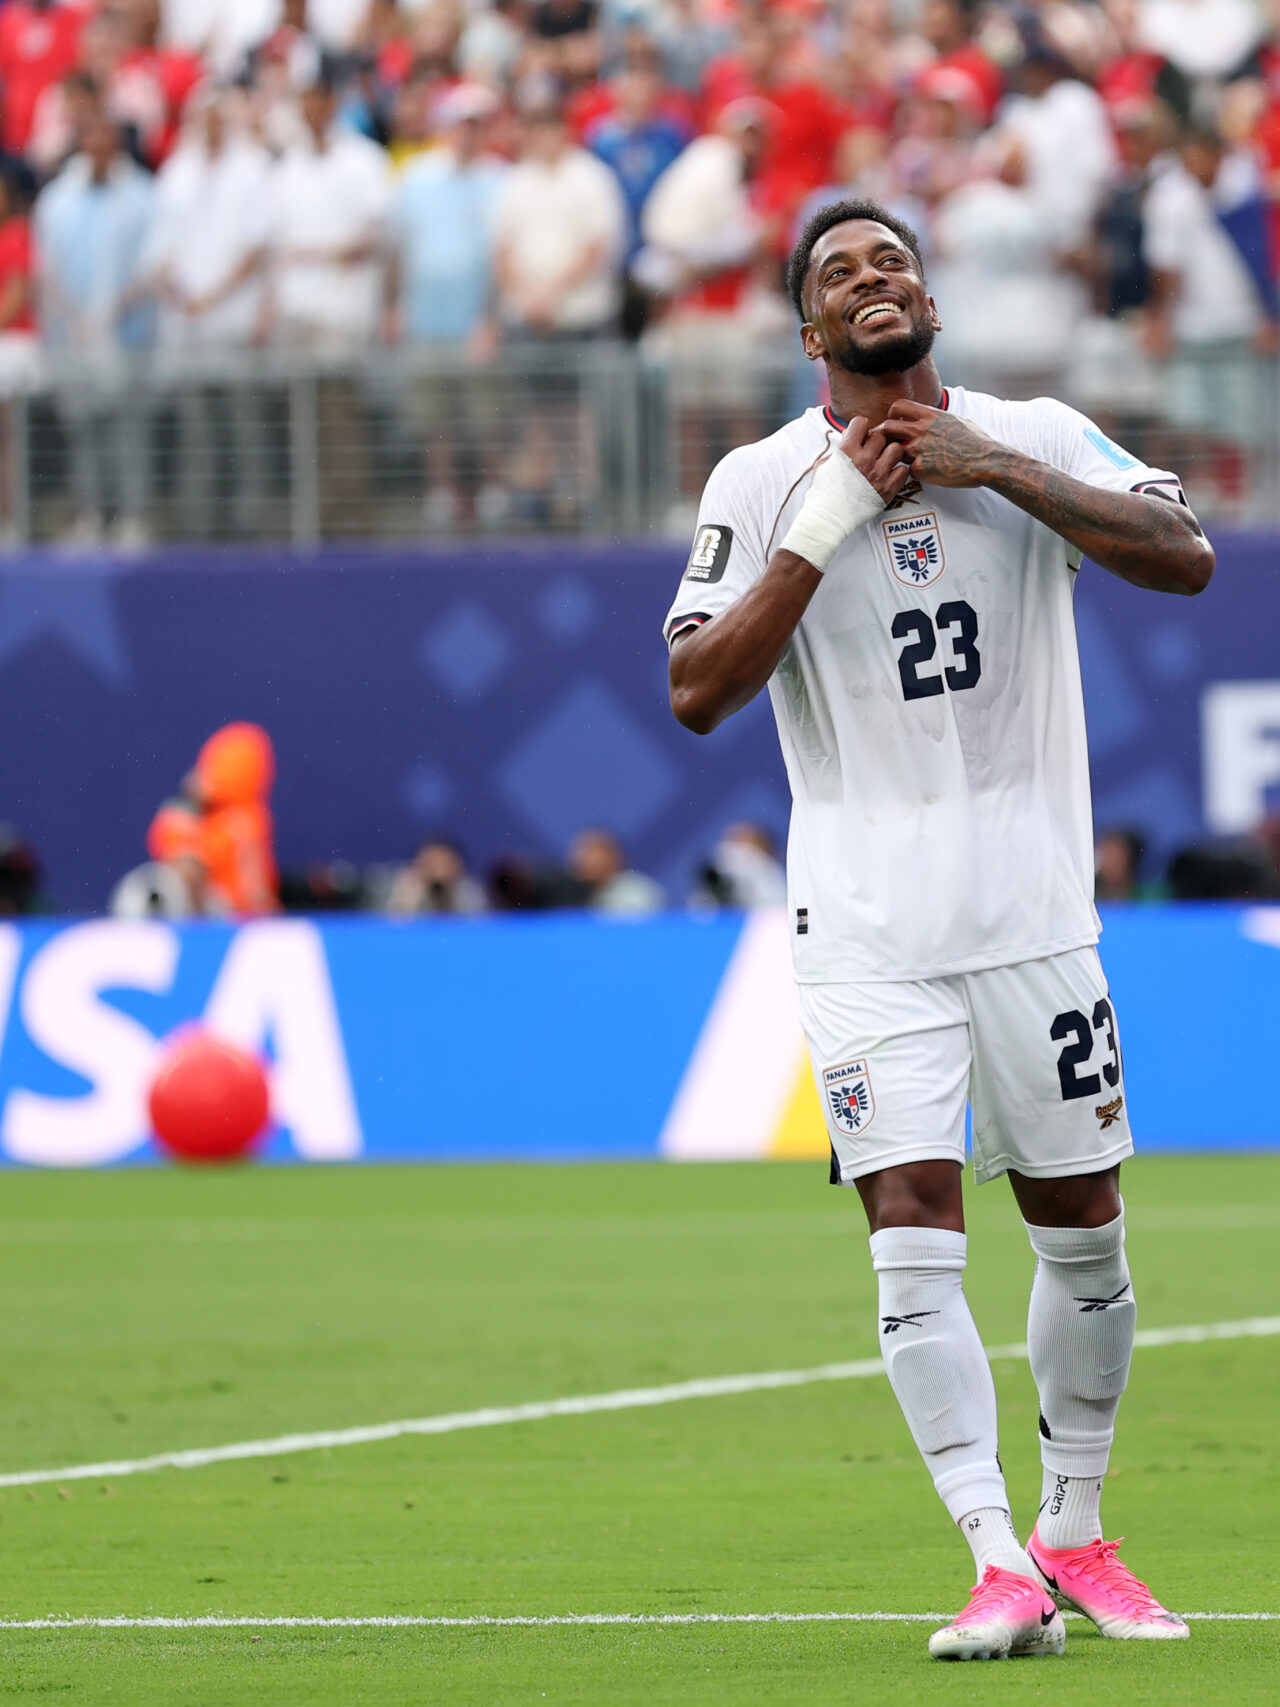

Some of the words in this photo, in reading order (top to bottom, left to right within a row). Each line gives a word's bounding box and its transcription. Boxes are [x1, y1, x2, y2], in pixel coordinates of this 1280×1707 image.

[891, 600, 981, 701] 23
[0, 920, 364, 1165] SA
[1050, 998, 1120, 1101] 23
[968, 1517, 982, 1531] 62
